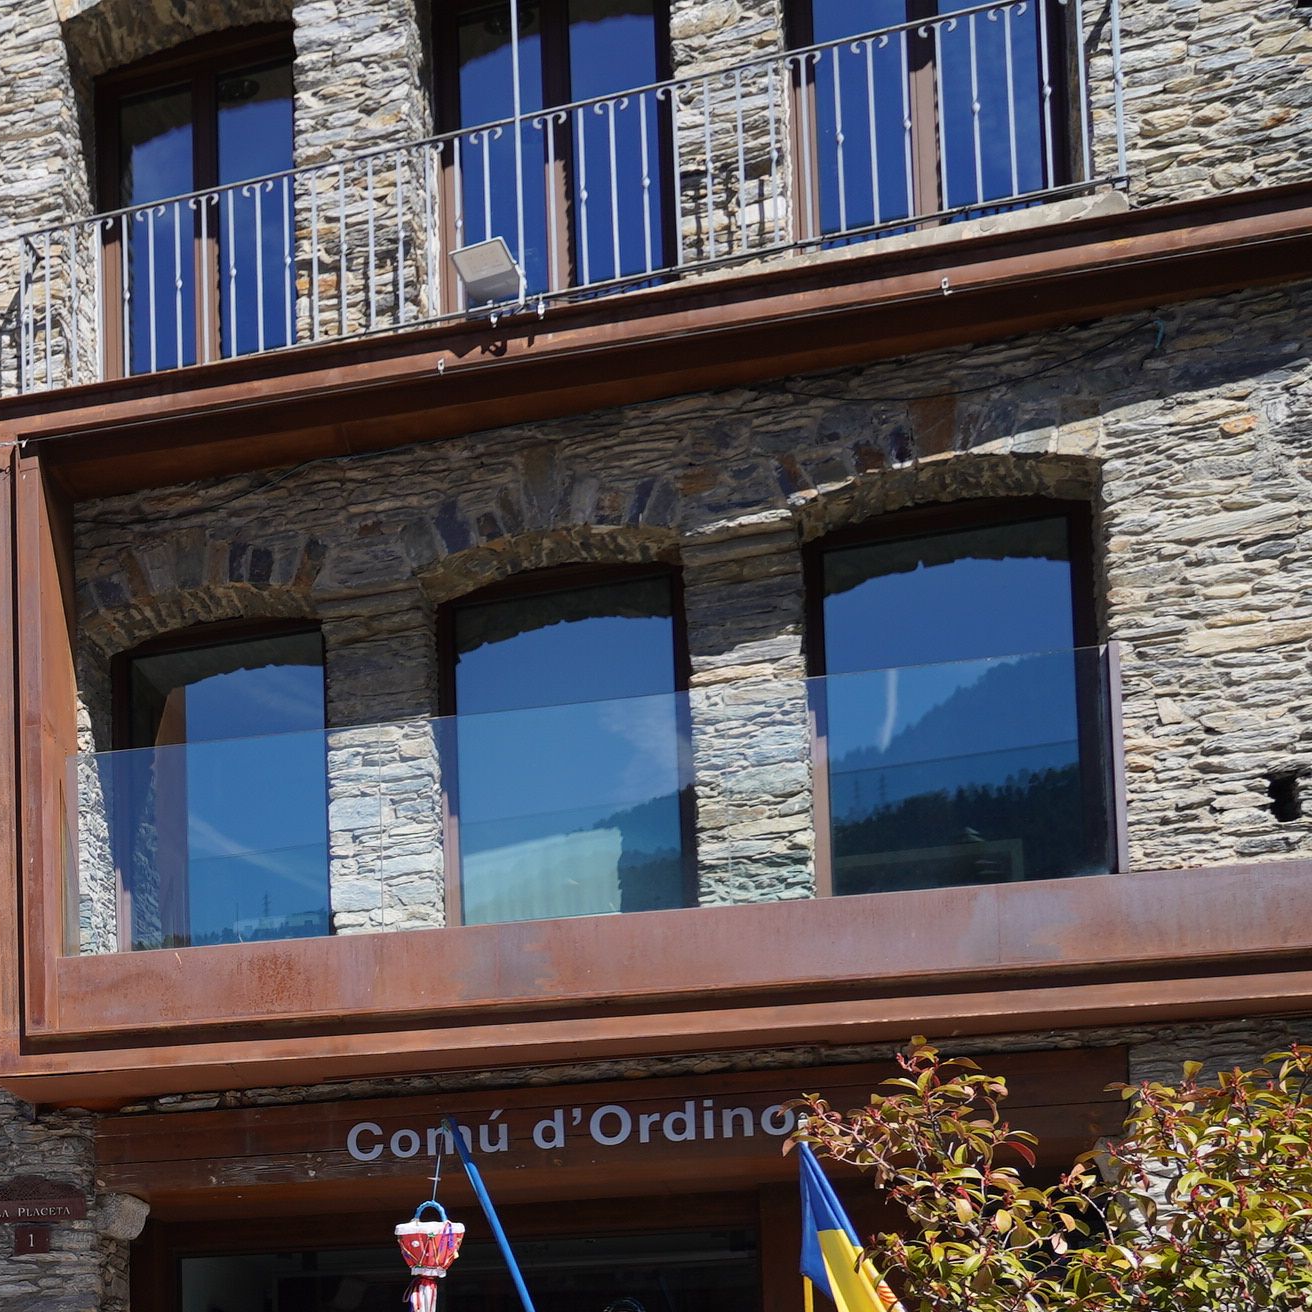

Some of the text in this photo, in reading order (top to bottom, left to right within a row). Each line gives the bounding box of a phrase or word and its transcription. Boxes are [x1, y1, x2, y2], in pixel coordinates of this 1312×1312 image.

[346, 1108, 509, 1162] Comú
[18, 1206, 71, 1217] PLACETA
[28, 1233, 34, 1248] 1
